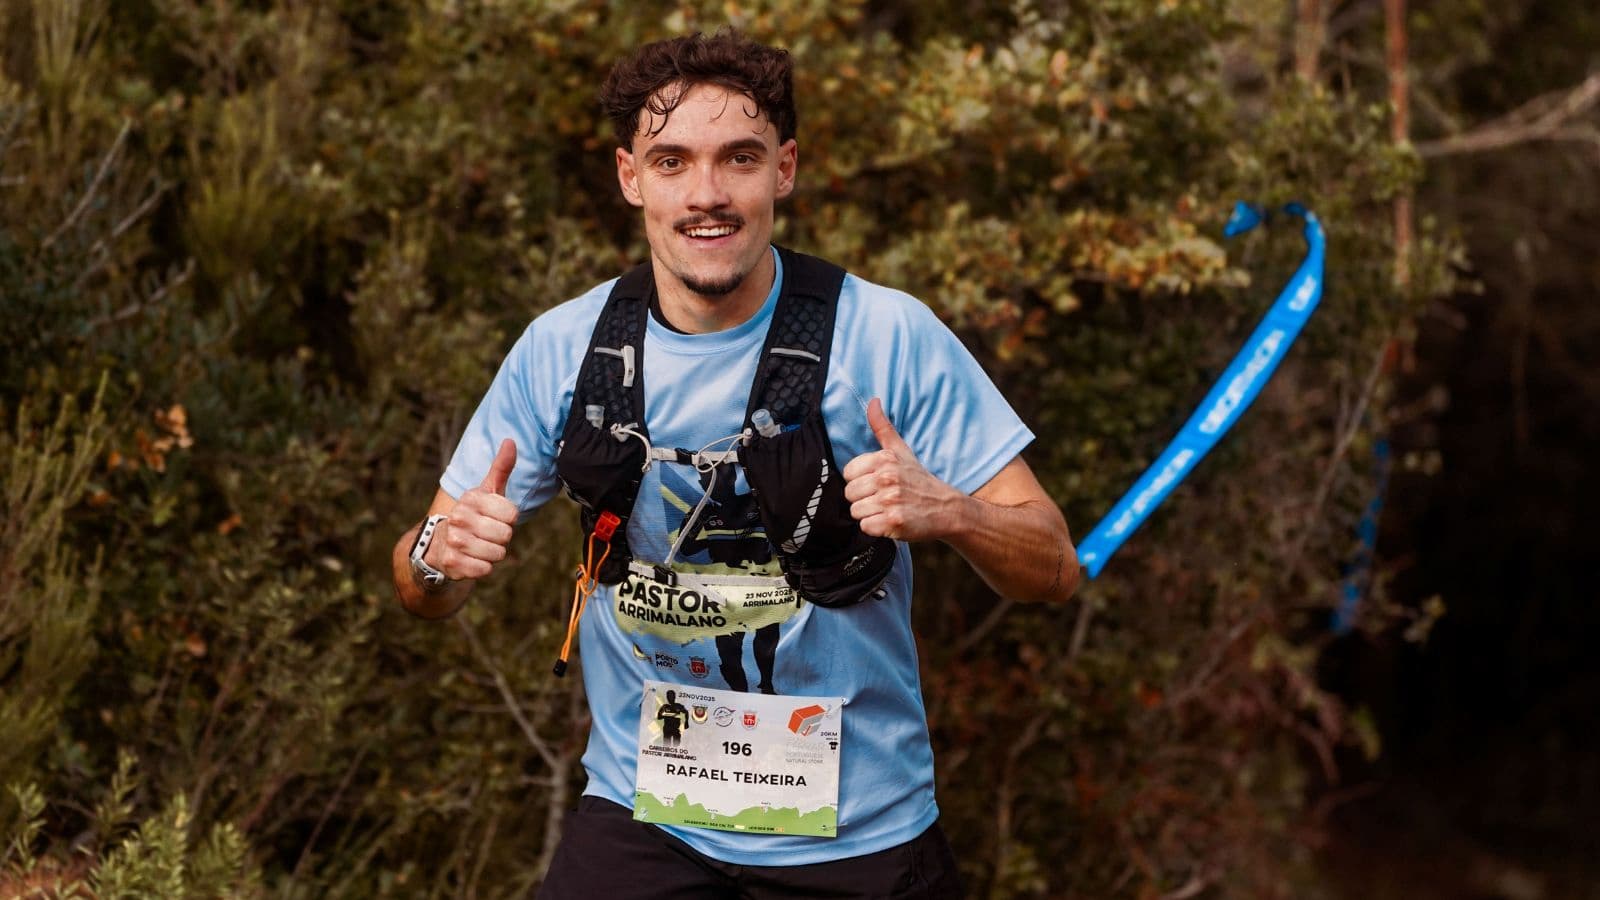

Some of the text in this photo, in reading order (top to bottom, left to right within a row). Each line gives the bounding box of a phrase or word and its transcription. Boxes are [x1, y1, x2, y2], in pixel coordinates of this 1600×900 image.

[619, 580, 721, 613] PASTOR
[743, 595, 796, 607] ARRIMALANO
[756, 591, 773, 599] NOV
[618, 600, 727, 628] ARRIMALANO
[722, 741, 752, 756] 196
[666, 763, 807, 787] RAFAEL TEIXEIRA
